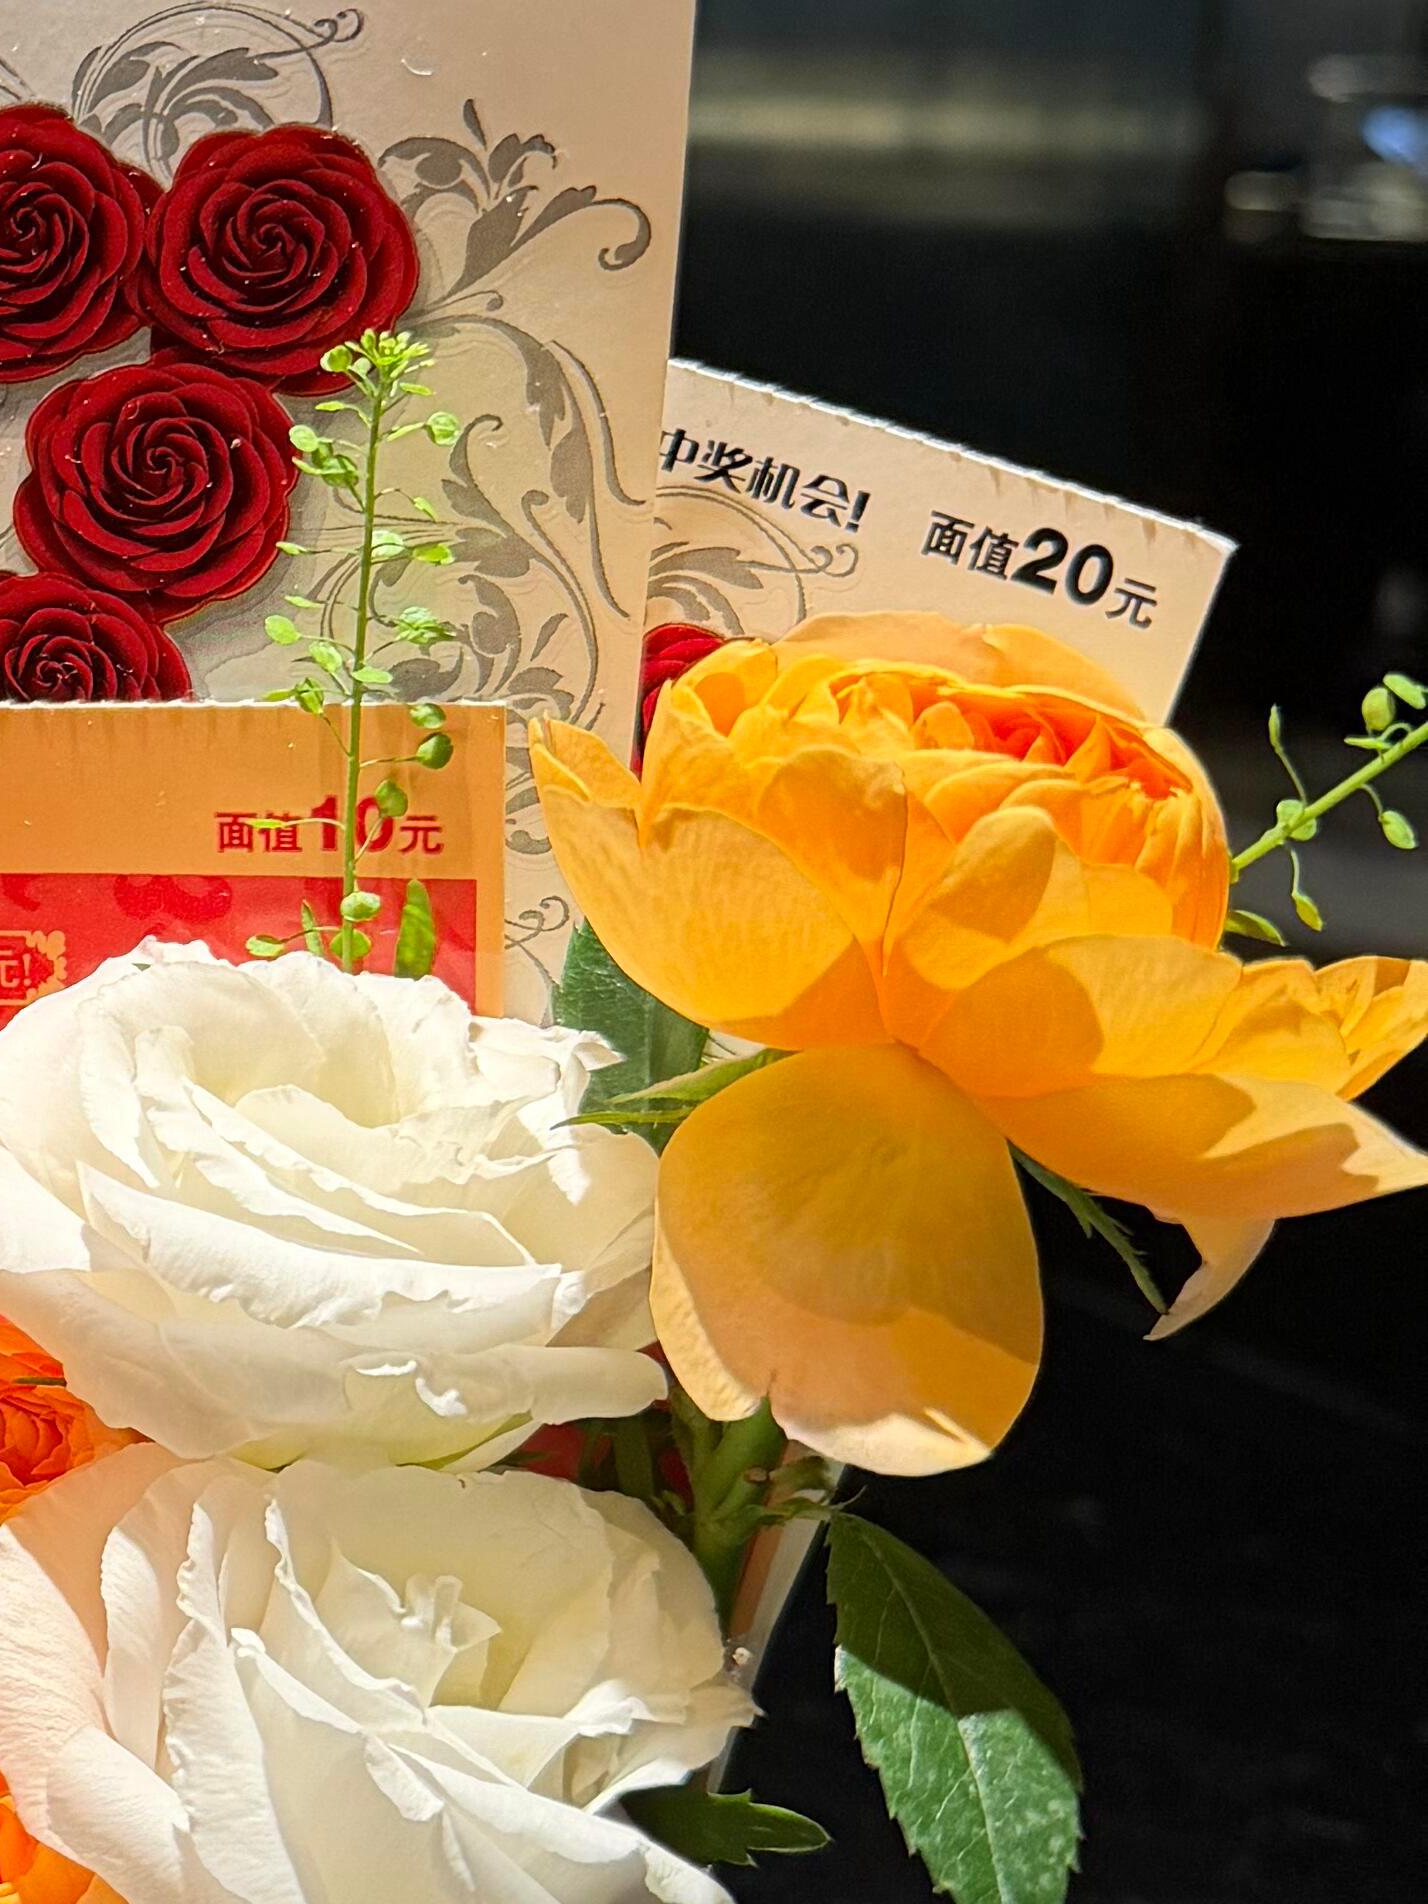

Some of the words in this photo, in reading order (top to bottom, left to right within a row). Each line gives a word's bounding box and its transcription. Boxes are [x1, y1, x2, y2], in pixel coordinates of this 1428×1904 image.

[919, 510, 1159, 629] 面值20元
[214, 794, 444, 854] 面值10元
